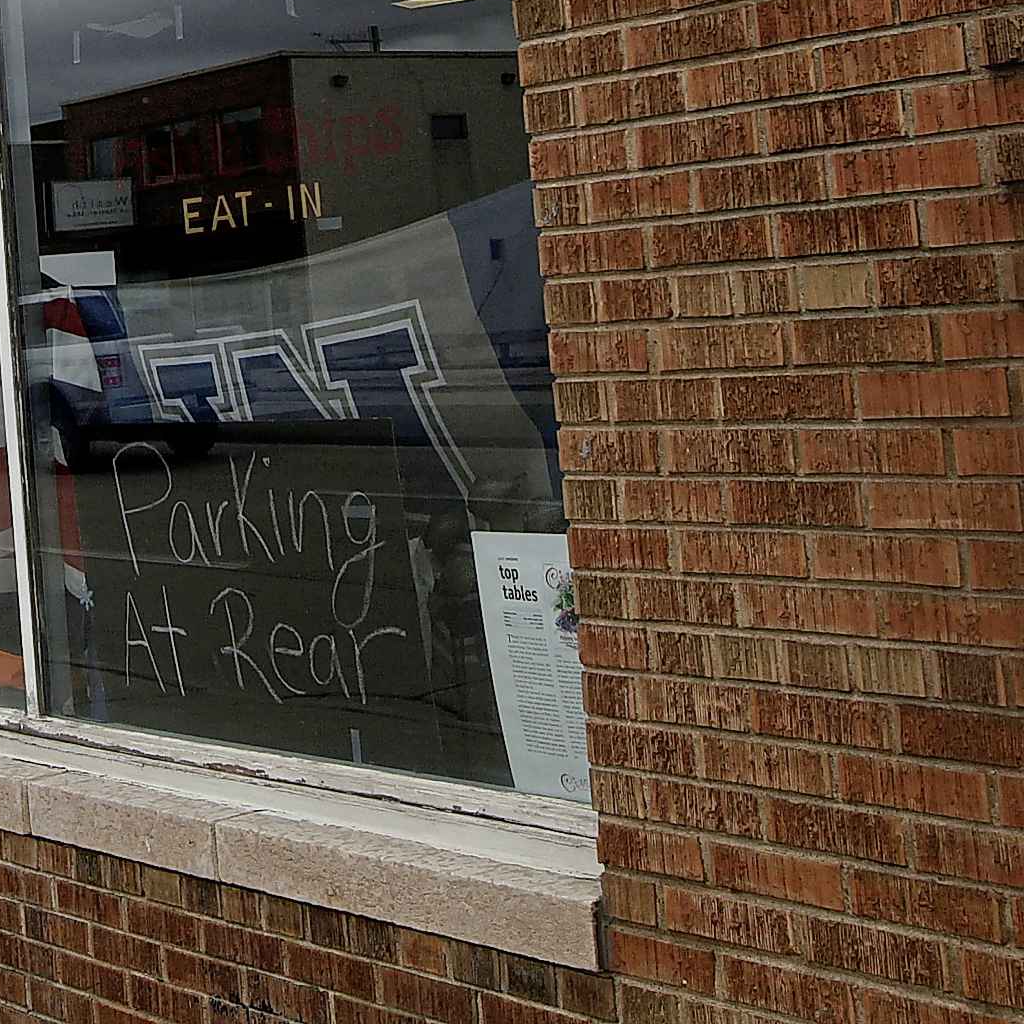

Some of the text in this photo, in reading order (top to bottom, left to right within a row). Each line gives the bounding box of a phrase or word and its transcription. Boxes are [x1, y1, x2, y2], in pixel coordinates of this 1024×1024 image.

[113, 441, 385, 629] Parking
[499, 565, 519, 584] top
[502, 585, 538, 602] tables
[125, 584, 189, 697] At
[209, 587, 408, 705] Rear
